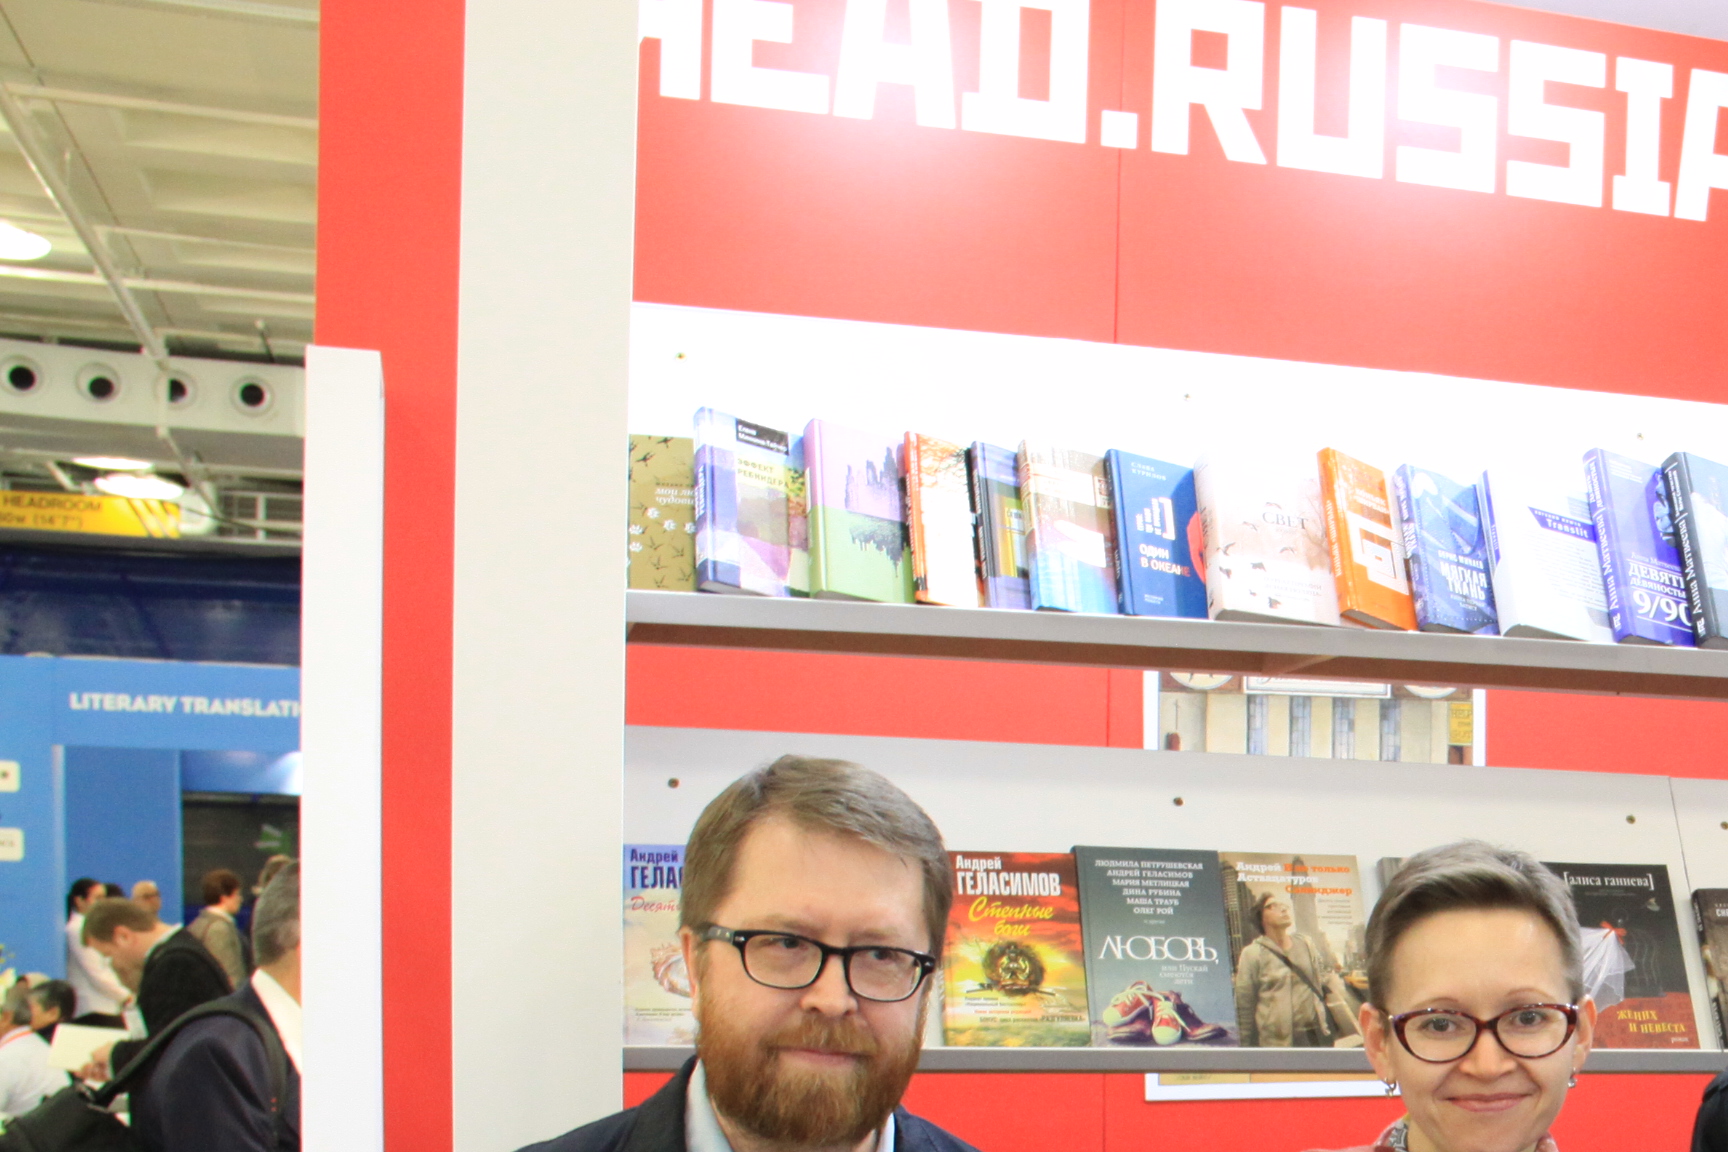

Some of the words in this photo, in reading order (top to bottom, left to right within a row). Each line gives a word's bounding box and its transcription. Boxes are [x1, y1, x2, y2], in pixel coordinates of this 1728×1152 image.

[737, 458, 774, 473] ЭФФЕКТ
[737, 468, 789, 488] РЕБИНДЕРА
[1262, 511, 1309, 531] СВЕТ
[1546, 517, 1589, 539] Translit
[1139, 543, 1170, 560] ОДИН
[1595, 514, 1615, 577] Матвеева
[1140, 557, 1149, 568] В
[1150, 558, 1191, 577] ОКЕАНЕ
[1440, 561, 1488, 588] МЯГКАЯ
[1446, 577, 1486, 601] ТКАНЬ
[68, 692, 176, 714] LITERARY
[630, 849, 678, 867] Андрей
[956, 855, 1002, 872] Андрей
[1095, 859, 1140, 869] ЛЮДМИЛА
[1140, 860, 1204, 871] ПЕТРУШЕВСКАЯ
[1106, 868, 1141, 878] АНДРЕЙ
[1142, 870, 1194, 880] ГЕЛАСИМОВ
[1236, 861, 1282, 874] Андрей
[1310, 865, 1351, 874] только
[956, 872, 1061, 896] ГЕЛАСИМОВ
[1112, 878, 1141, 887] МАРИЯ
[1141, 879, 1190, 889] МЕТЛИЦКАЯ
[1122, 888, 1147, 897] ДИНА
[1148, 888, 1182, 898] РУБИНА
[968, 896, 1054, 921] Степные
[1126, 897, 1154, 906] МАША
[1154, 897, 1180, 907] ТРАУБ
[1133, 906, 1155, 915] ОЛЕГ
[1156, 906, 1174, 916] РОЙ
[994, 920, 1031, 936] боги
[1099, 935, 1219, 965] ЛЮБОВЬ,
[1617, 1009, 1658, 1022] ЖЕНИХ
[1629, 1022, 1638, 1032] И
[1640, 1021, 1686, 1033] НЕВЕСТА
